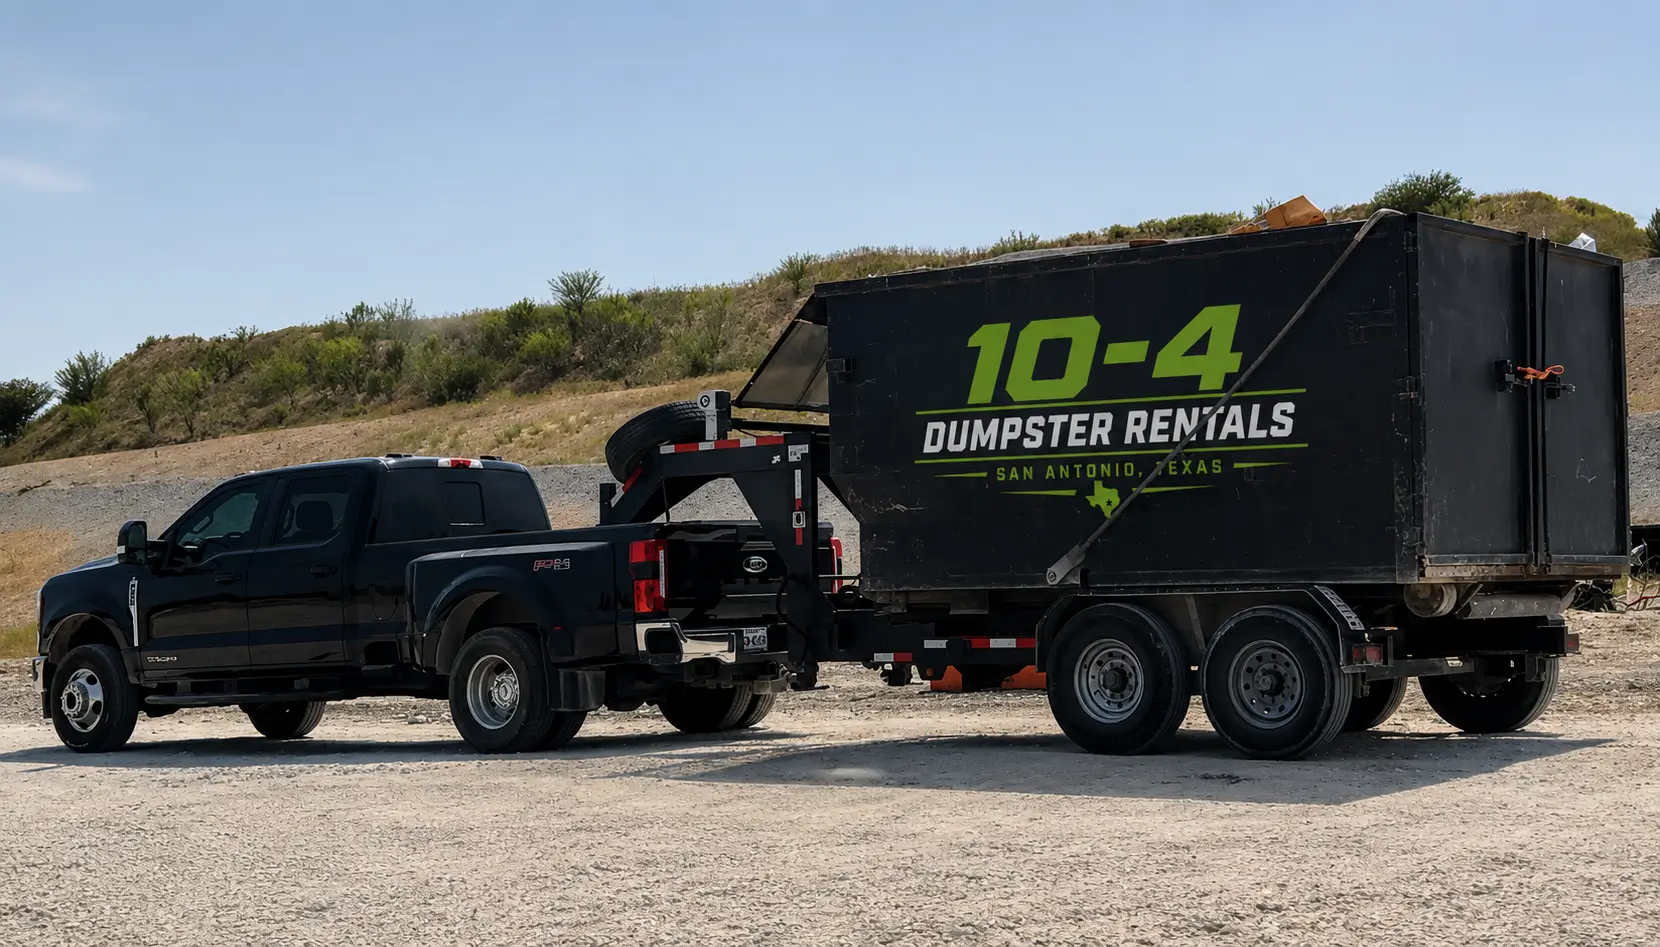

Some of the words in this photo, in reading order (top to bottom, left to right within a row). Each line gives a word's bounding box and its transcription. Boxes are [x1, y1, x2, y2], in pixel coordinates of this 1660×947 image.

[967, 304, 1243, 404] 10-4
[922, 412, 1113, 453] DUMPSTER
[1124, 402, 1295, 444] RENTALS
[996, 466, 1033, 481] SAN
[1045, 461, 1142, 479] ANTONIO,
